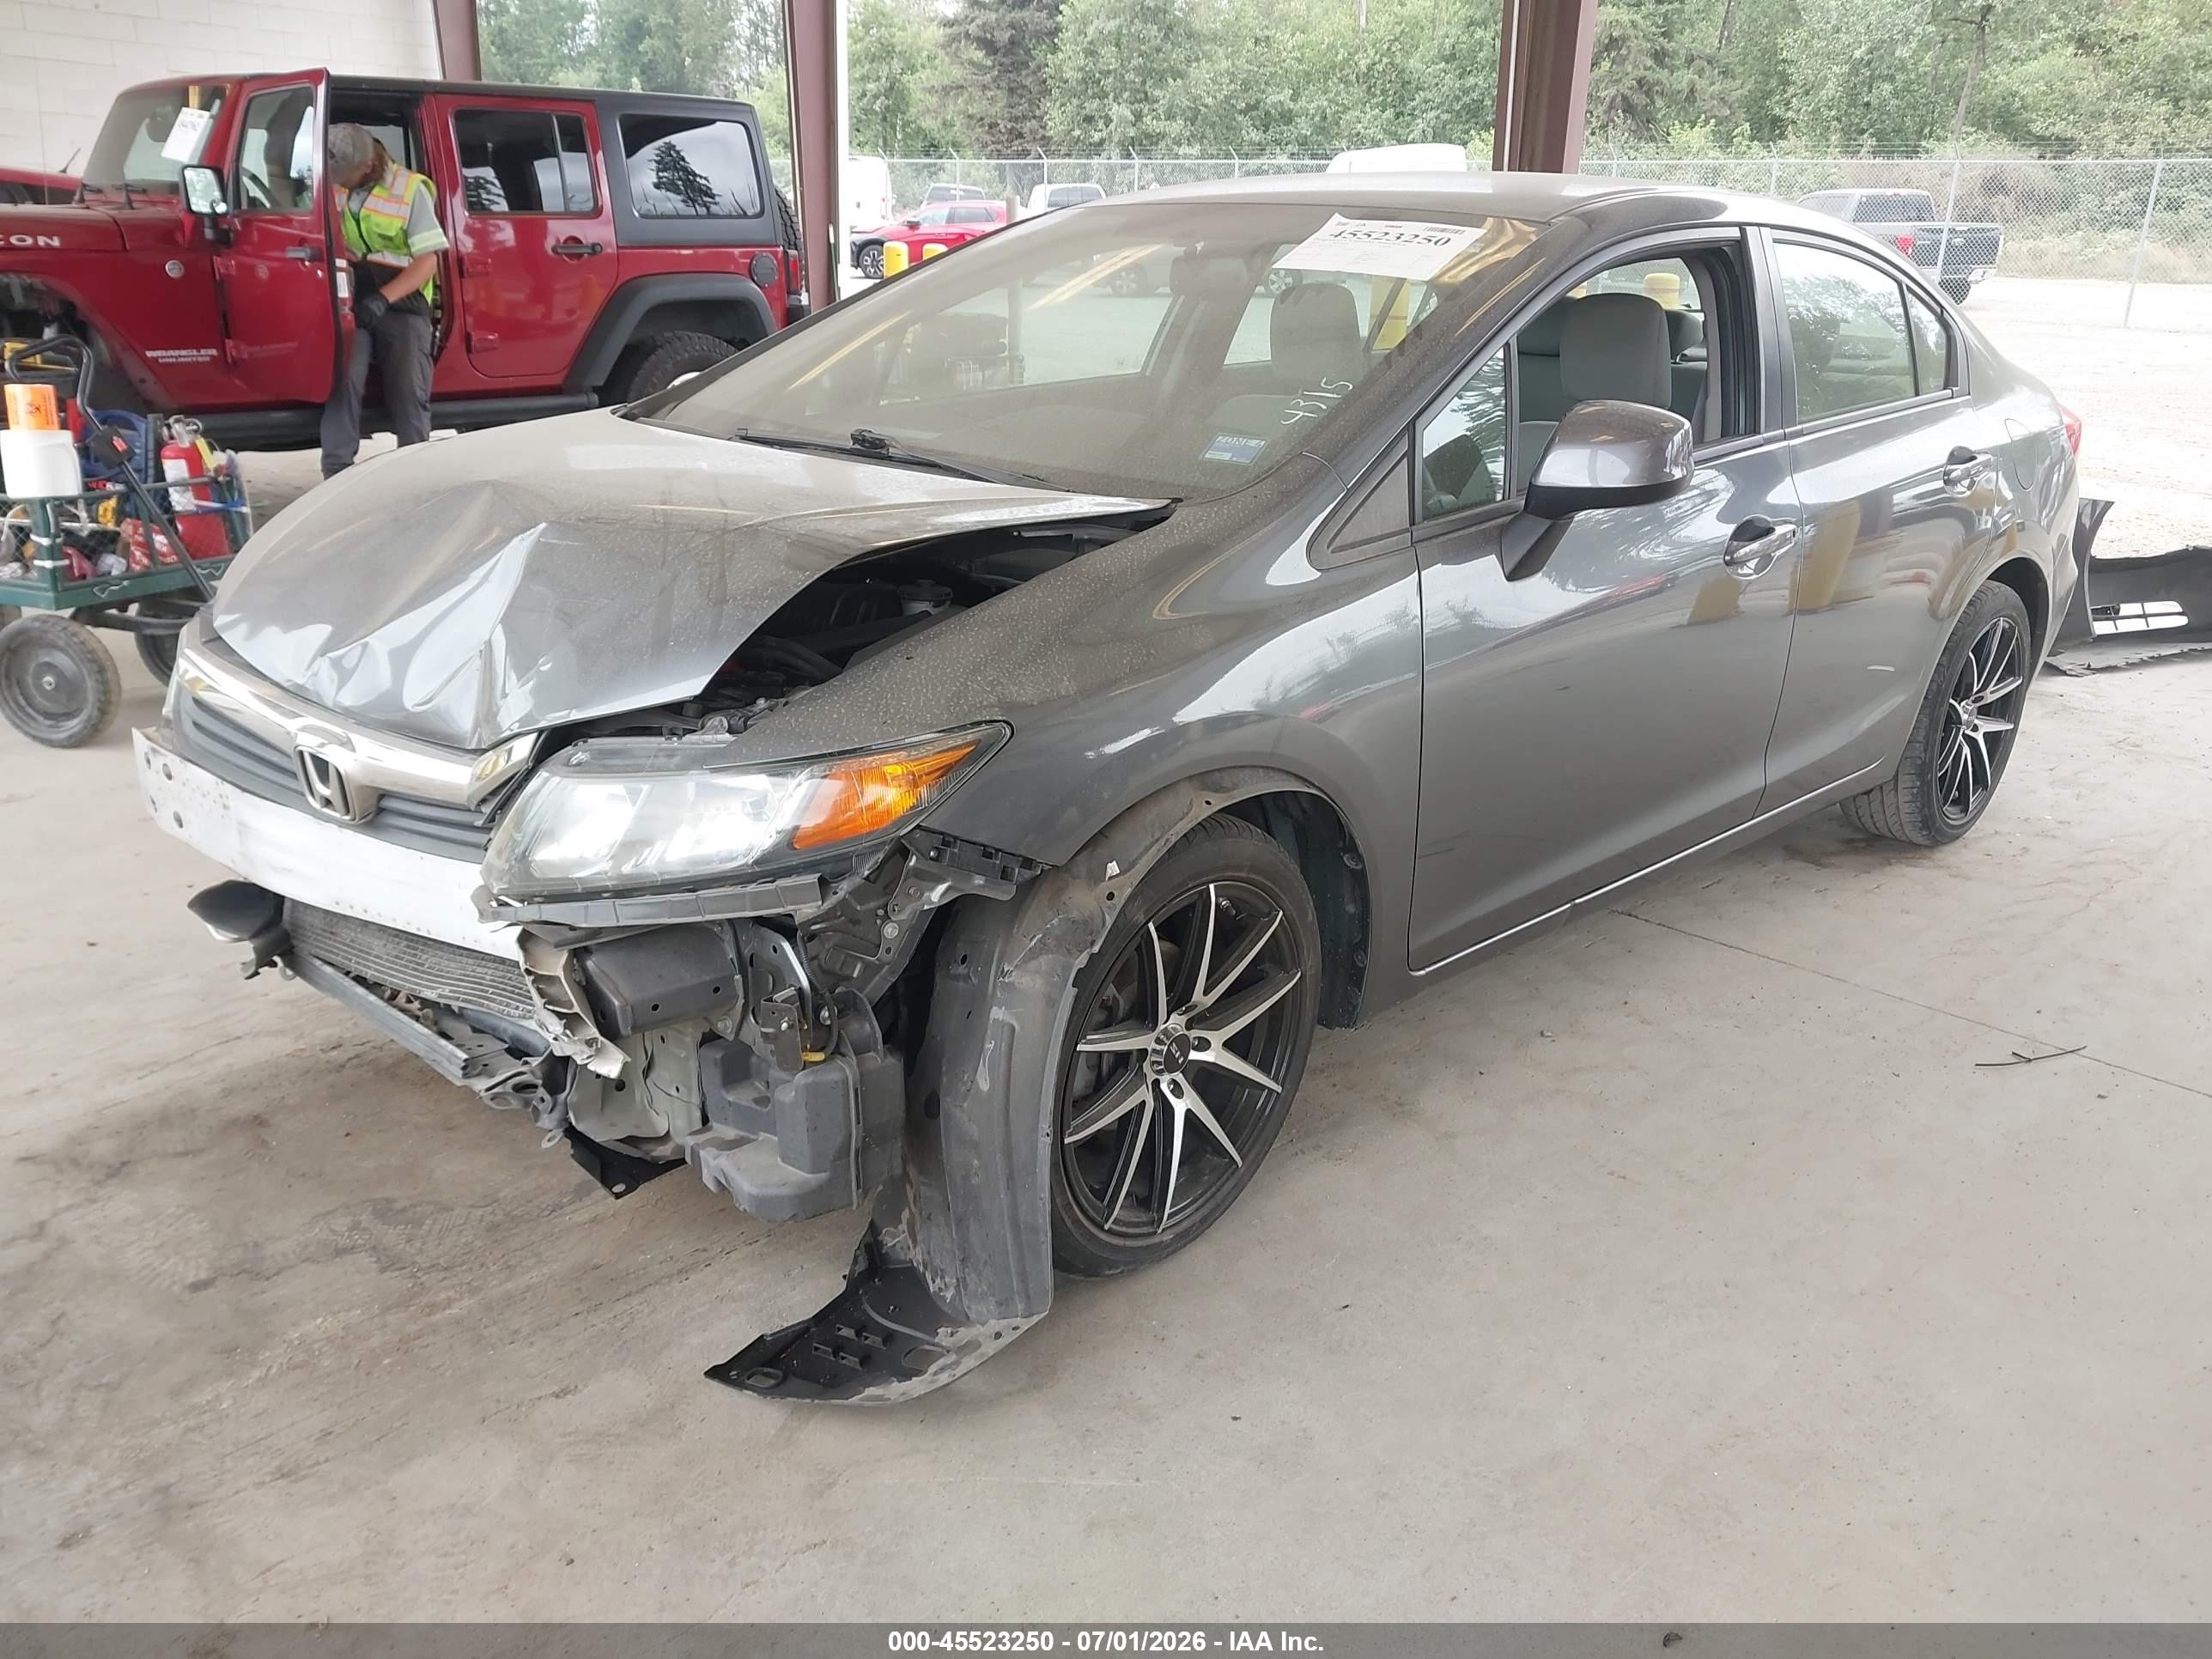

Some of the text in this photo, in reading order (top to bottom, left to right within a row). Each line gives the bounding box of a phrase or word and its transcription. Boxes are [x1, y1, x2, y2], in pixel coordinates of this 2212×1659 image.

[0, 234, 60, 247] ON
[1328, 228, 1452, 247] 45523250
[144, 348, 218, 358] WRANGLER
[1280, 377, 1353, 425] 4315
